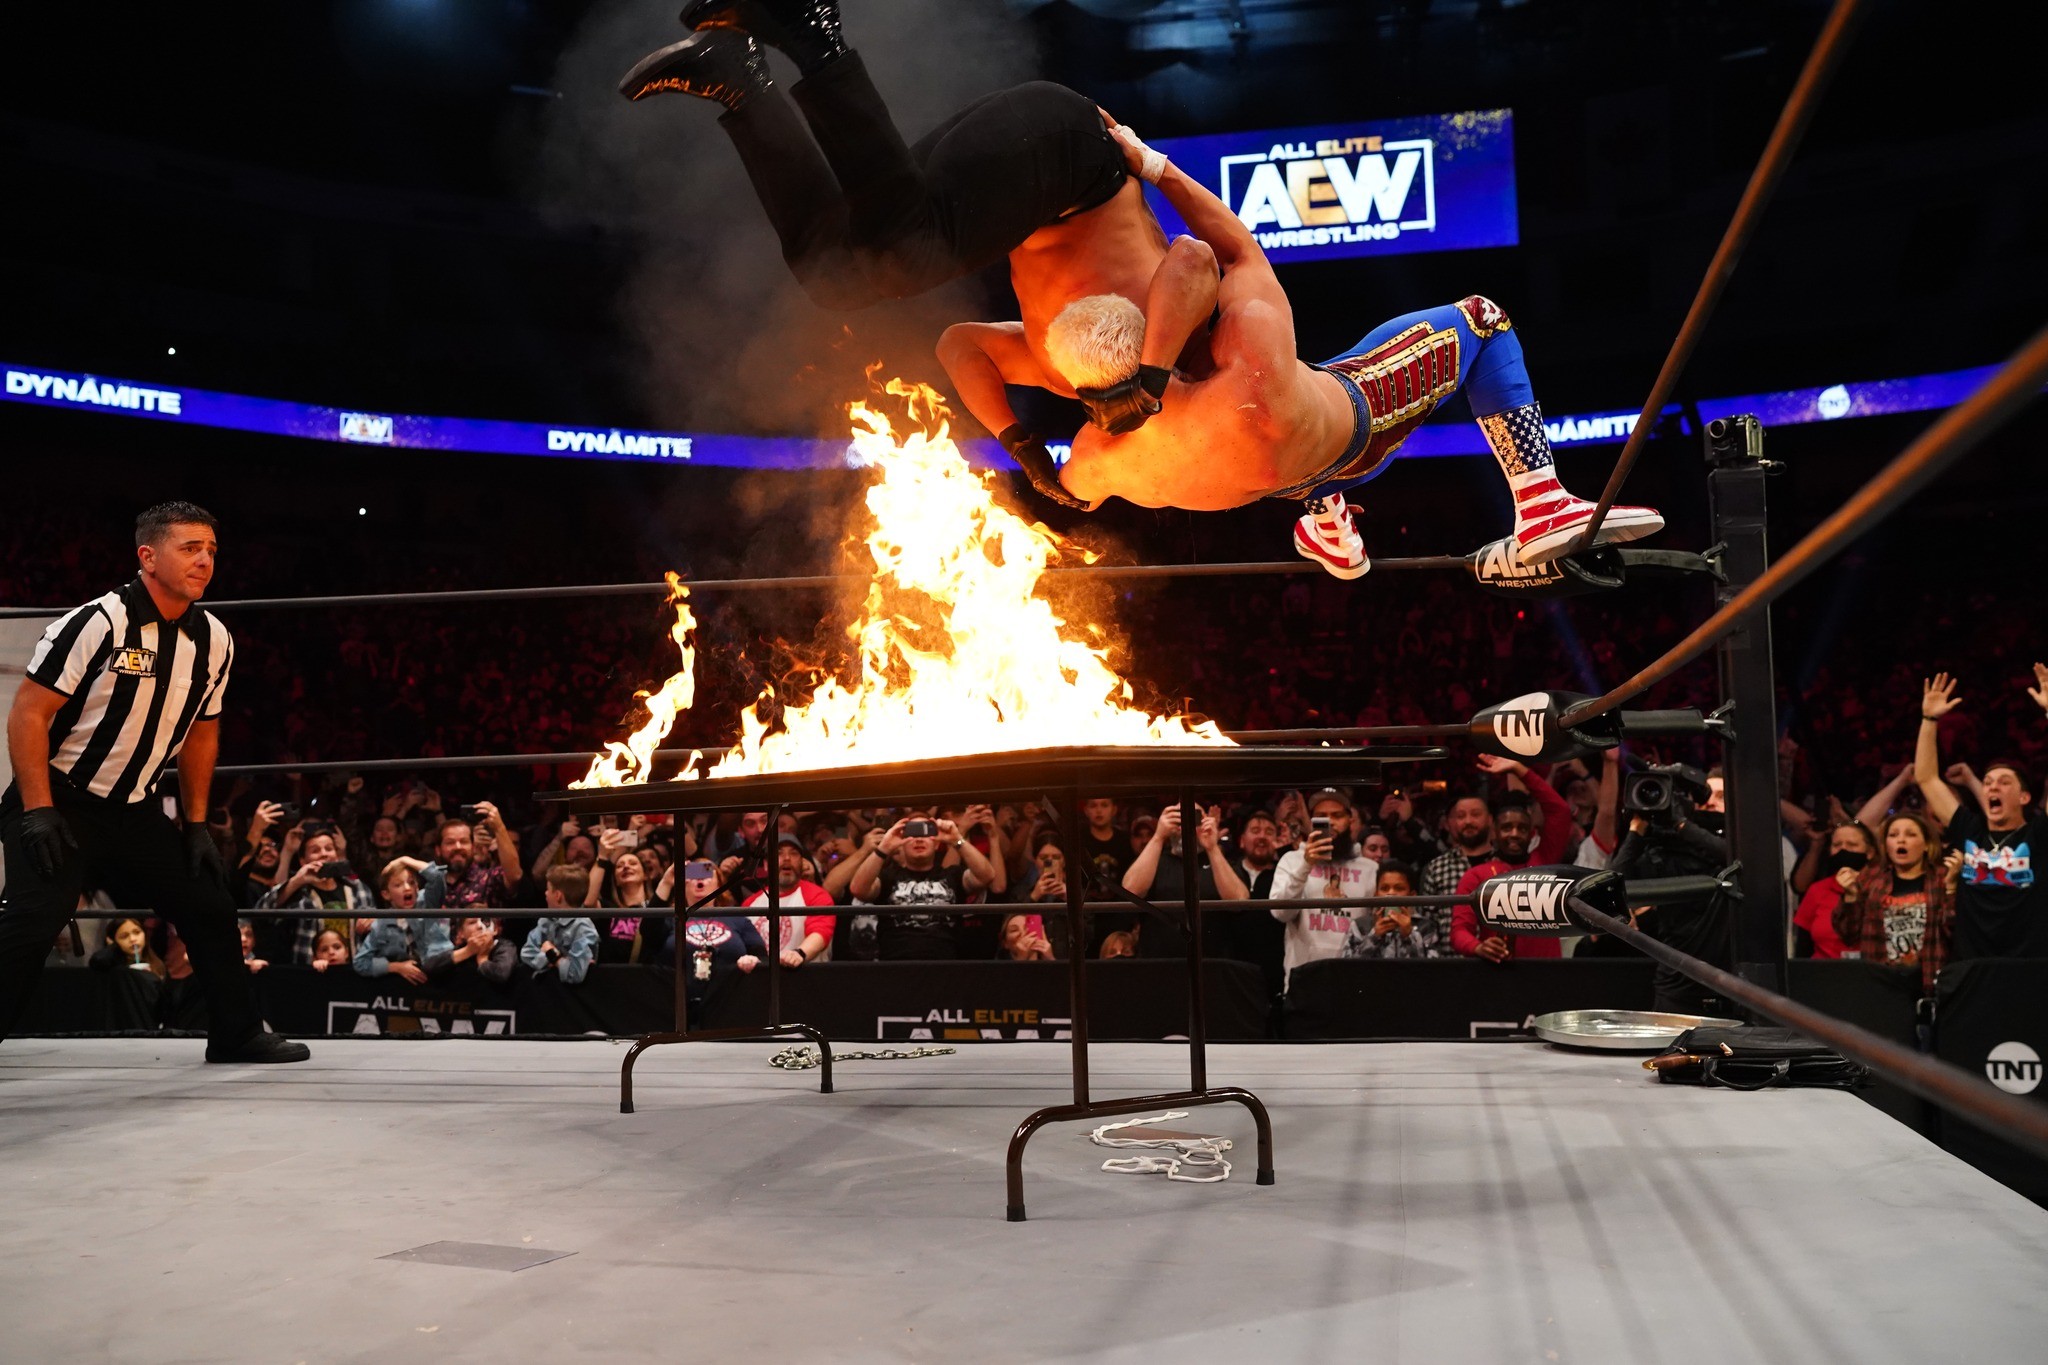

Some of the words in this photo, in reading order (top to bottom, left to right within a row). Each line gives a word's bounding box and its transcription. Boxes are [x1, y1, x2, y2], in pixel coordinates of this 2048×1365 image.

[1268, 142, 1314, 161] ALL
[1316, 136, 1384, 156] ELITE
[1236, 151, 1422, 230] AEW
[1258, 222, 1400, 249] WRESTLING
[6, 371, 181, 415] DYNAMITE
[548, 428, 692, 458] DYNAMITE
[1495, 577, 1553, 589] WRESTLING
[113, 651, 154, 672] AEW
[1497, 707, 1547, 738] TNT
[1508, 874, 1527, 882] ALL
[1528, 874, 1557, 882] ELITE
[1487, 882, 1566, 921] AEW
[1500, 921, 1561, 931] WRESTLING
[371, 996, 410, 1012] ALL
[413, 999, 472, 1015] ELITE
[926, 1009, 970, 1024] ALL
[974, 1009, 1039, 1024] ELITE
[1987, 1060, 2041, 1080] TNT
